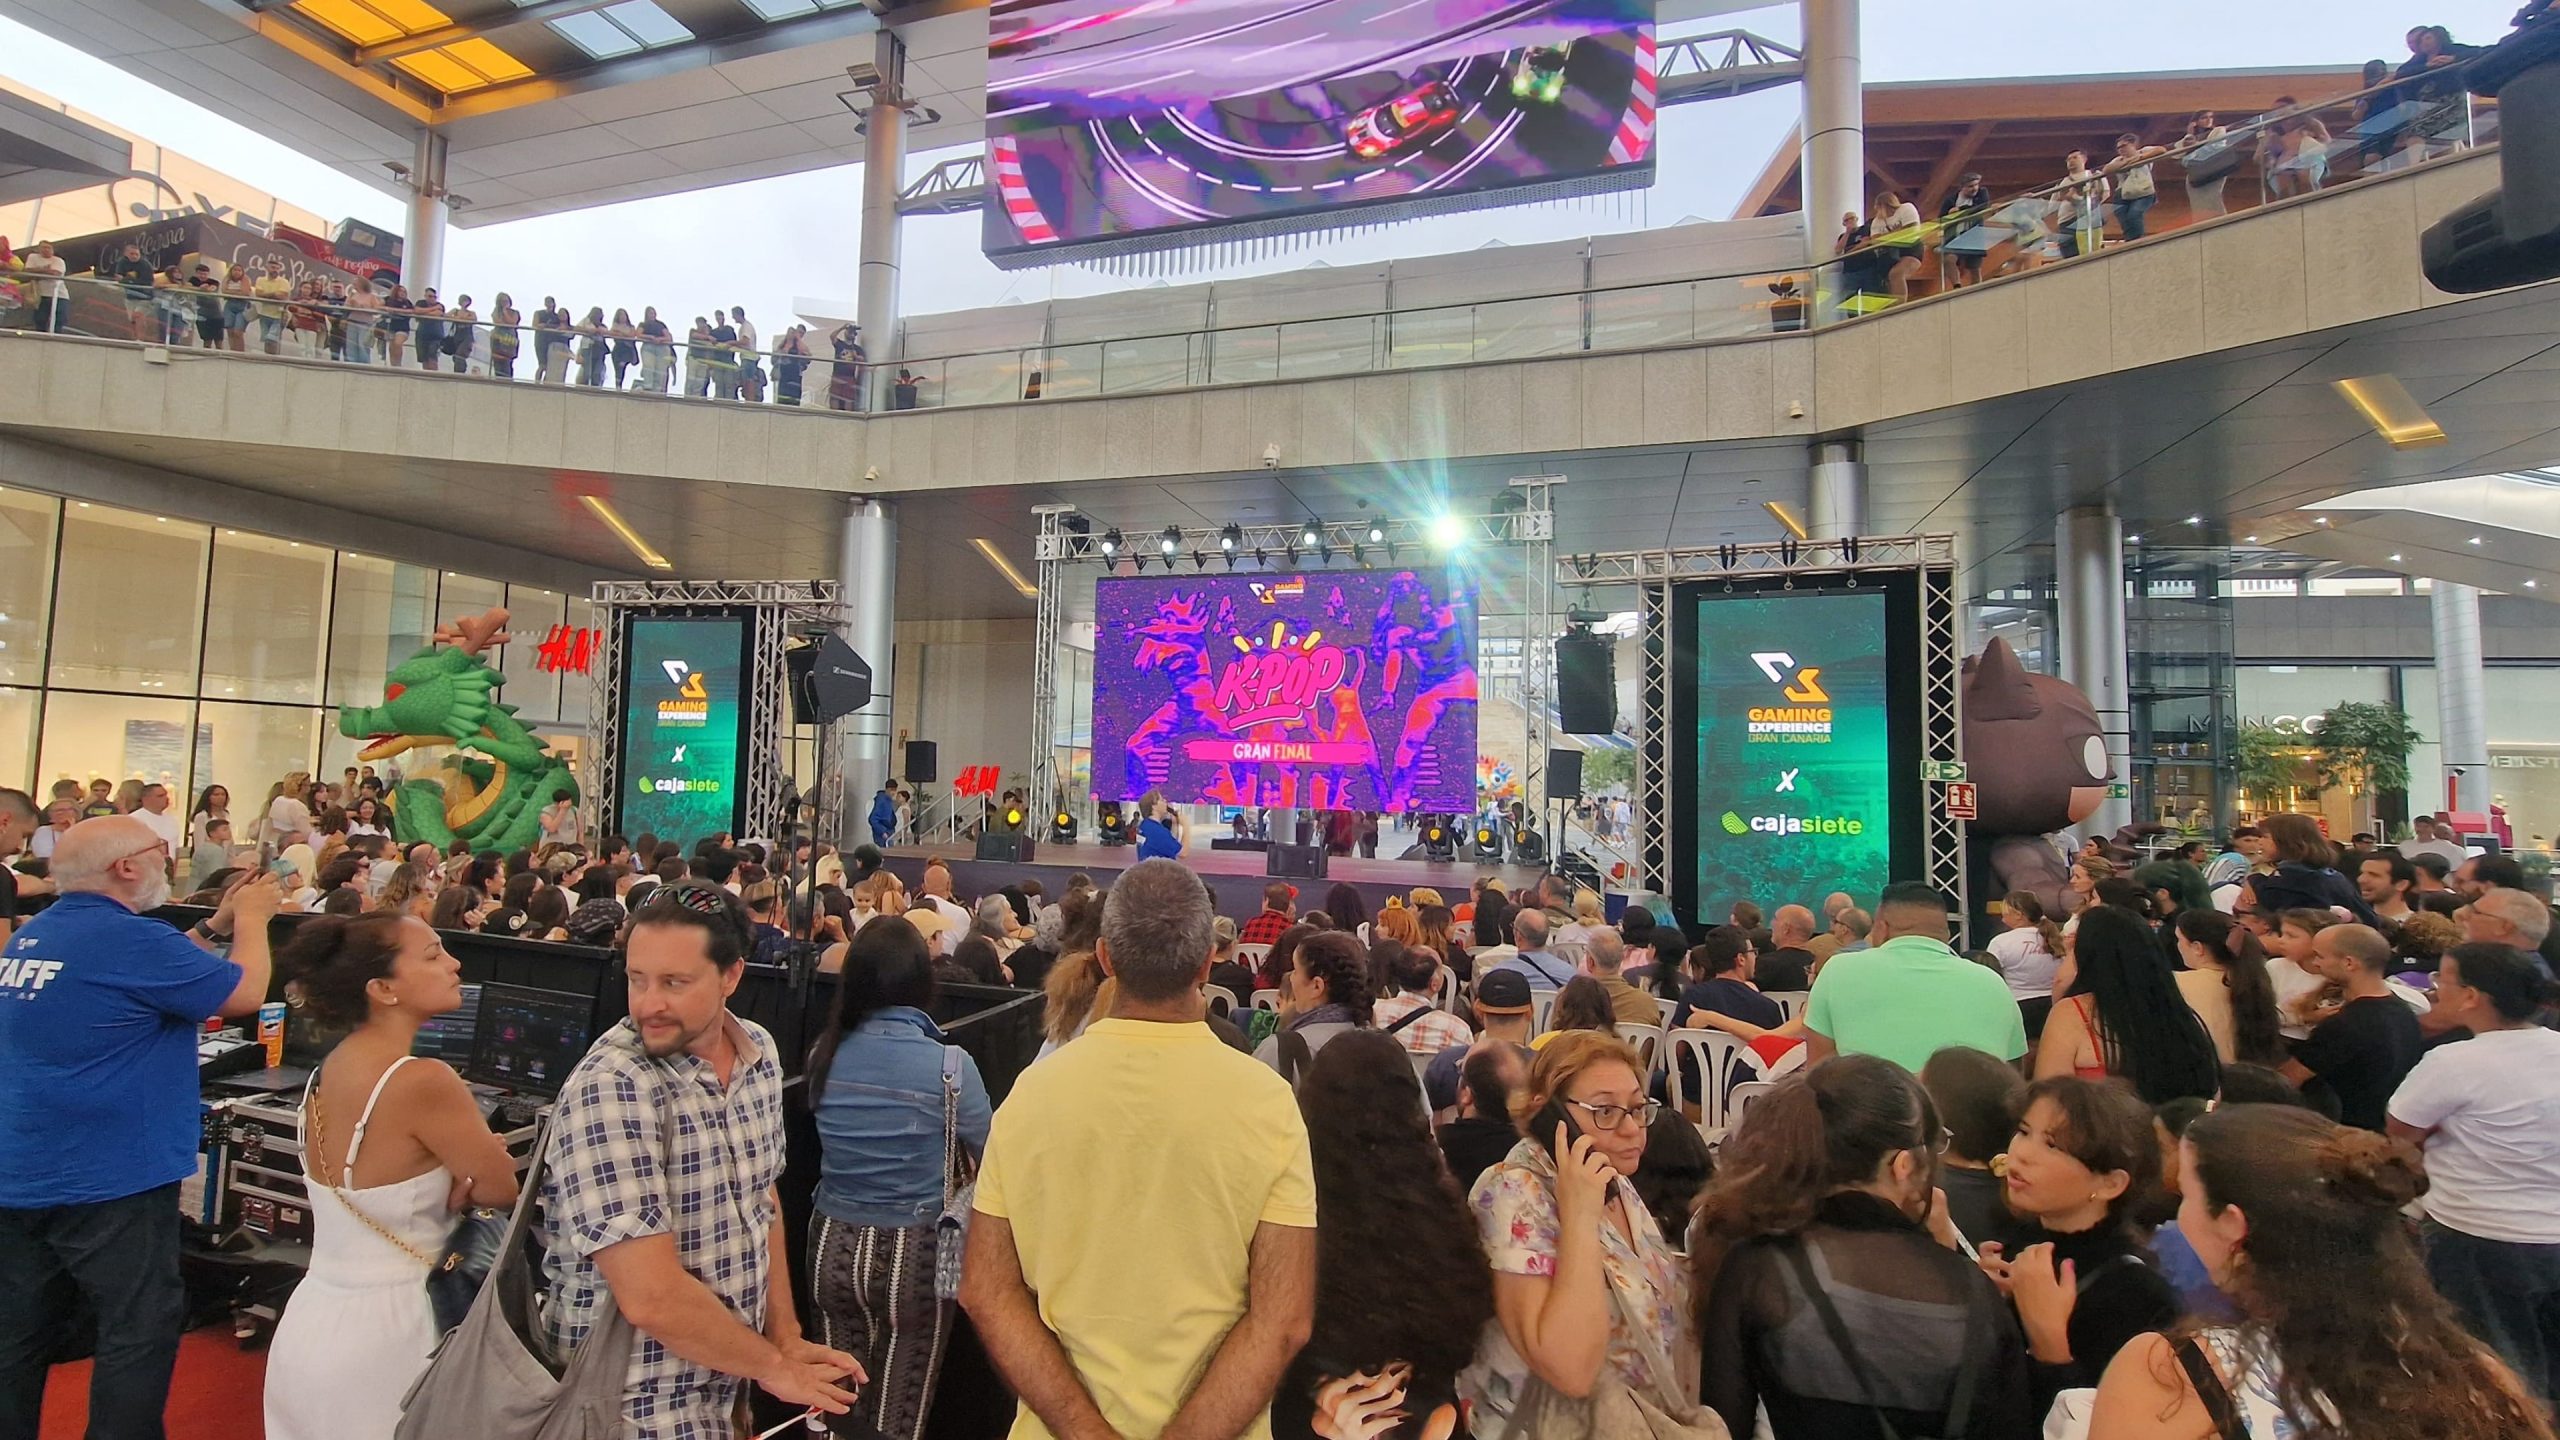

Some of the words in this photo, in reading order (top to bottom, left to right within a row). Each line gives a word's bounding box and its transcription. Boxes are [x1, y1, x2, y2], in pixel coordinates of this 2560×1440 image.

[1215, 646, 1346, 712] K-POP
[658, 700, 708, 712] GAMING
[1749, 707, 1832, 722] GAMING
[1748, 722, 1832, 733] EXPERIENCE
[1748, 733, 1779, 744] GRAN
[1781, 733, 1832, 744] CANARIA
[1233, 742, 1271, 761] GRAN
[1273, 743, 1313, 761] FINAL
[655, 776, 720, 794] cajasiete
[953, 765, 1000, 799] H&M
[1750, 813, 1863, 836] cajasiete
[0, 957, 64, 989] TAFF
